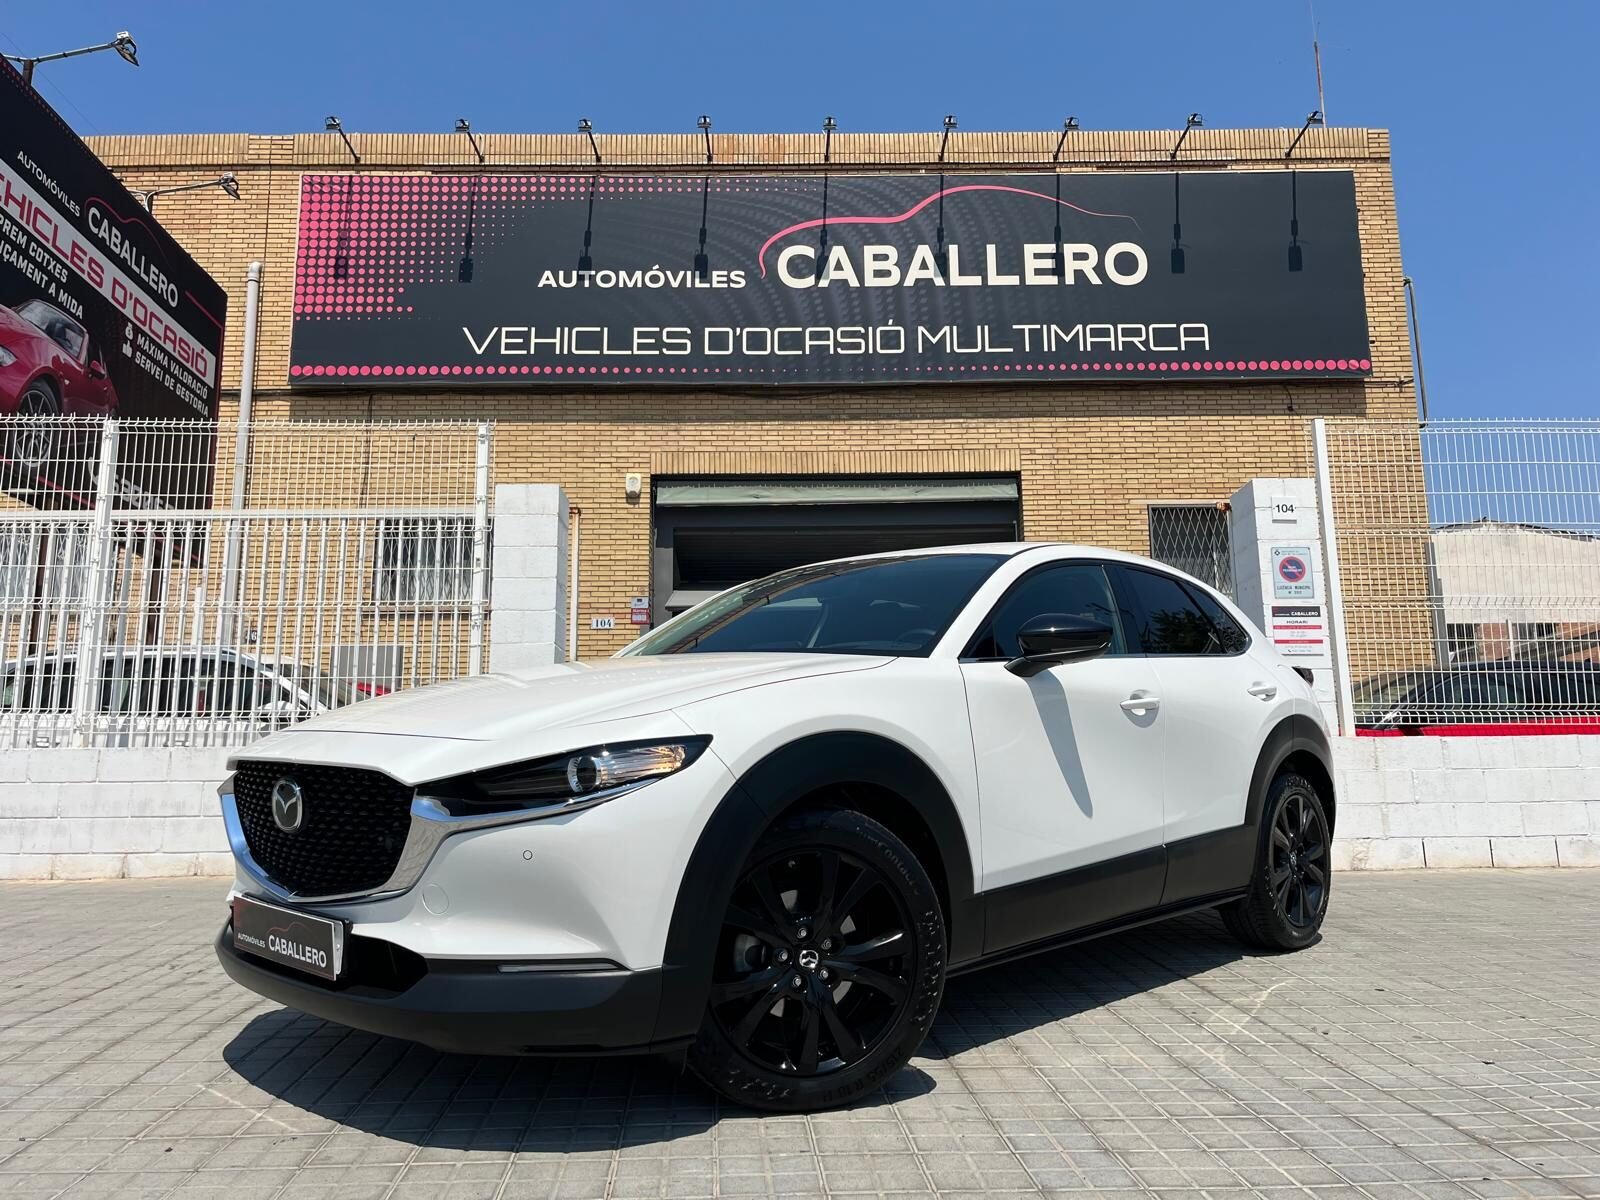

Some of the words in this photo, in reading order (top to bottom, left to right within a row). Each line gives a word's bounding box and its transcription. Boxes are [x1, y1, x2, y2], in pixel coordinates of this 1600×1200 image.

[17, 151, 80, 217] AUTOMÓVILES
[88, 207, 178, 308] CABALLERO
[0, 173, 105, 289] HICLES
[111, 276, 208, 379] D'OCASIÓ
[29, 241, 68, 283] COTXES
[537, 265, 746, 288] AUTOMÓVILES
[777, 241, 1148, 289] CABALLERO
[48, 282, 56, 297] A
[58, 288, 83, 319] MIDA
[462, 326, 692, 356] VEHICLES
[704, 319, 905, 356] D'OCASIÓ
[135, 351, 164, 382] SERVEI
[164, 374, 175, 391] DE
[175, 383, 209, 418] GESTORIA
[1275, 503, 1295, 514] 104
[595, 619, 612, 628] 104
[237, 932, 266, 948] AUTOMÓVILES
[268, 935, 327, 968] CABALLERO
